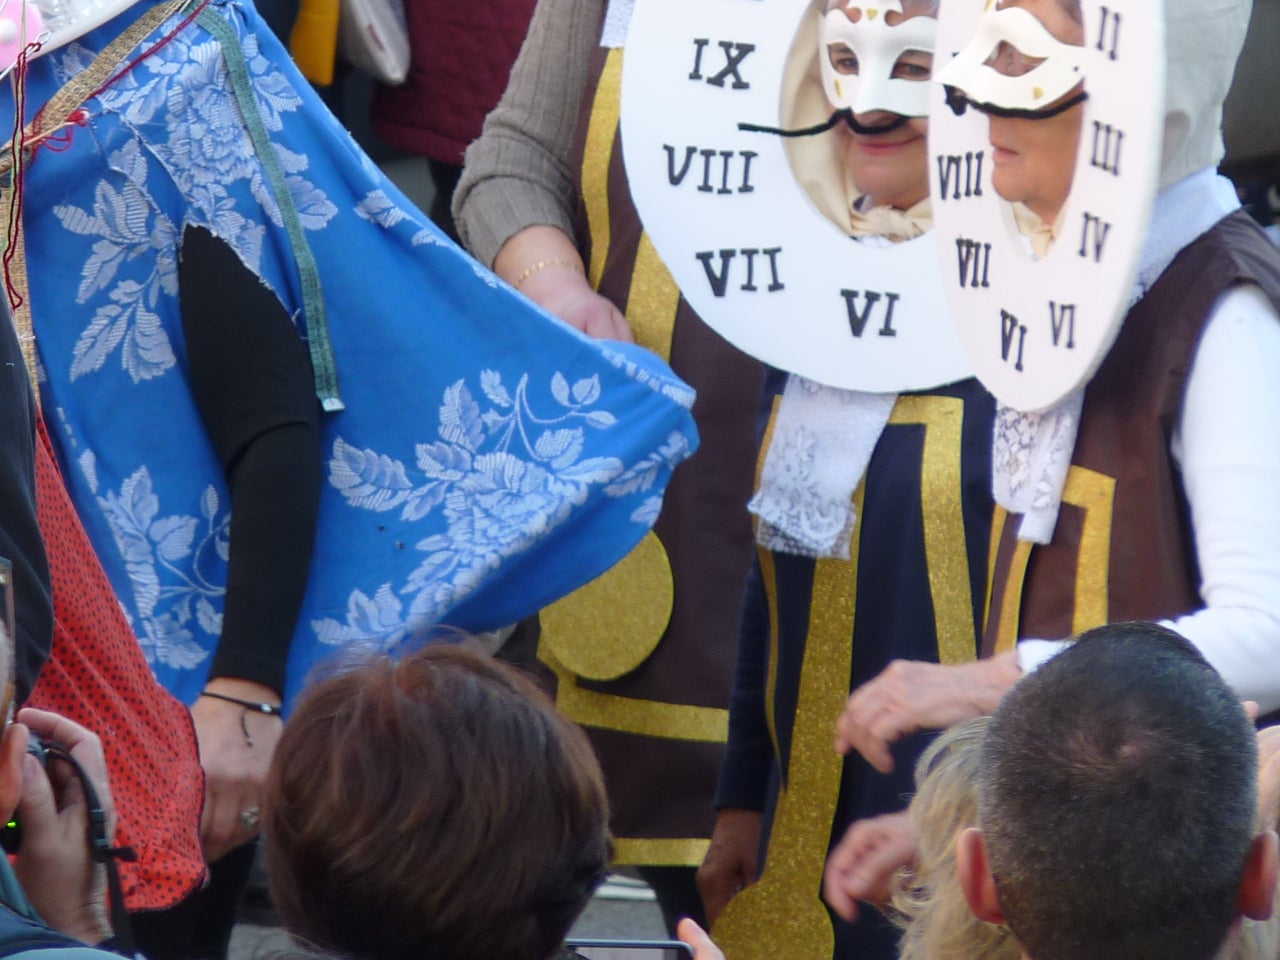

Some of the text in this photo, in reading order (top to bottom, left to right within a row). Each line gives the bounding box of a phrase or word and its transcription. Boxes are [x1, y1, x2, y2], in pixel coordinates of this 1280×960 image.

[1098, 7, 1119, 60] II
[689, 39, 755, 89] IX
[663, 145, 758, 194] VIII
[1092, 121, 1122, 175] III
[938, 152, 983, 199] VIII
[1080, 213, 1109, 260] IV
[696, 248, 784, 297] VII
[956, 239, 991, 287] VII
[841, 290, 899, 337] VI
[1050, 302, 1074, 348] VI
[1001, 309, 1026, 371] VI
